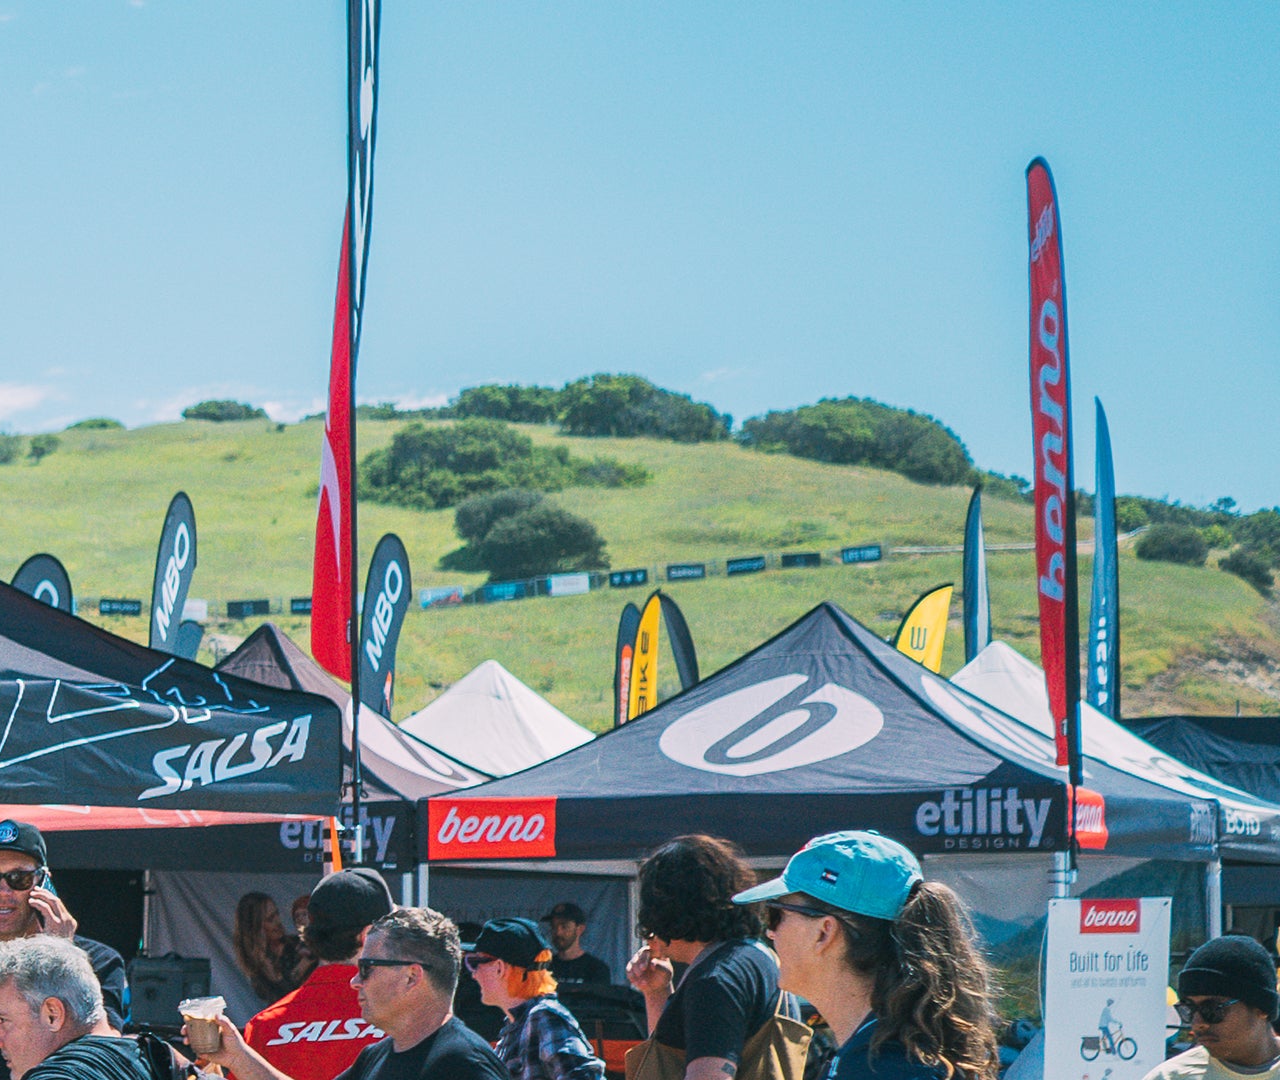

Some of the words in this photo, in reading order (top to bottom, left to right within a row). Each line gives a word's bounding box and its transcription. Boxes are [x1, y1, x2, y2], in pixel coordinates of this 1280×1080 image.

[1038, 298, 1065, 603] benno
[156, 521, 190, 642] MBO
[366, 560, 403, 672] MBO
[138, 714, 313, 801] SALSA
[436, 805, 544, 844] benno
[916, 788, 1053, 847] etility
[944, 838, 1021, 850] DESIGN
[1084, 905, 1138, 927] benno
[1070, 951, 1099, 973] Built
[1104, 951, 1123, 971] for
[1126, 951, 1149, 971] Life
